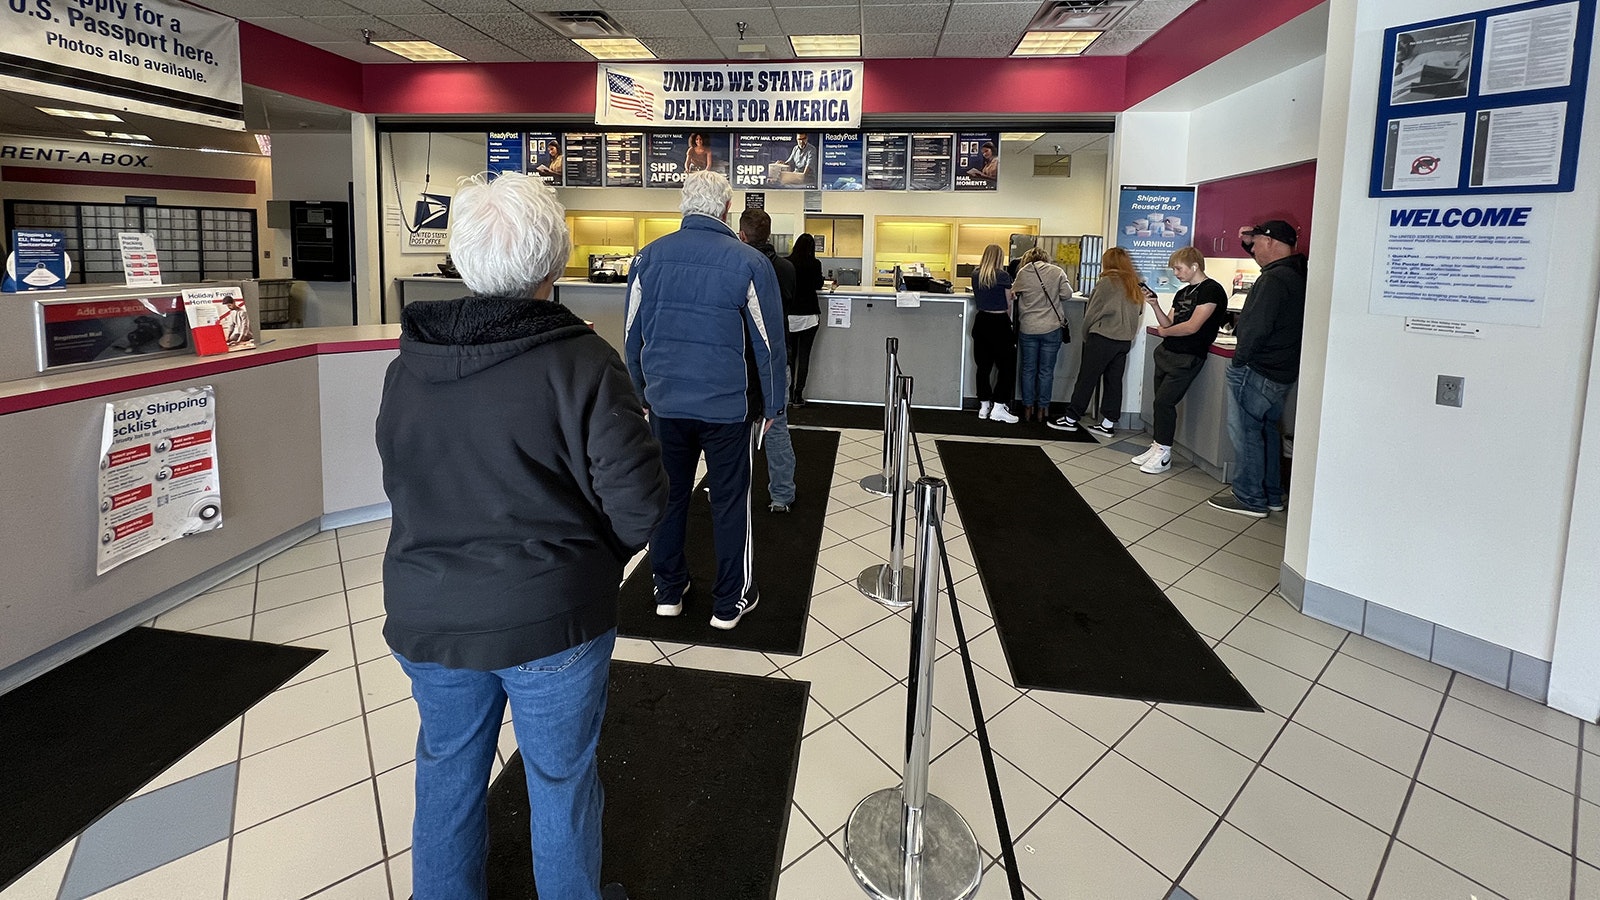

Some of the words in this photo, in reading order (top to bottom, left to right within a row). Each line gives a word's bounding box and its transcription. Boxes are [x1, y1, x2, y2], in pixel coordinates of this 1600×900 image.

[74, 0, 127, 19] pply
[134, 3, 163, 27] for
[170, 18, 181, 33] a
[9, 0, 60, 23] U.S.
[67, 6, 167, 53] Passport
[174, 37, 219, 66] here.
[46, 31, 104, 58] Photos
[109, 49, 140, 66] also
[144, 58, 207, 83] available.
[663, 70, 724, 92] UNITED
[726, 70, 753, 92] WE
[757, 70, 815, 92] STAND
[818, 69, 854, 92] AND
[664, 99, 734, 121] DELIVER
[737, 99, 769, 121] FOR
[774, 99, 850, 122] AMERICA
[489, 132, 518, 140] ReadyPost
[825, 133, 858, 142] ReadyPost
[650, 162, 678, 172] SHIP
[736, 165, 765, 175] SHIP
[736, 175, 767, 185] FAST
[1136, 194, 1170, 203] Shipping
[1131, 203, 1160, 211] Reused
[1389, 207, 1532, 228] WELCOME
[1133, 240, 1175, 248] WARNING!
[76, 307, 96, 316] Add
[98, 306, 121, 314] extra
[114, 408, 143, 423] iday
[146, 397, 208, 415] Shipping
[113, 418, 157, 438] ecklist
